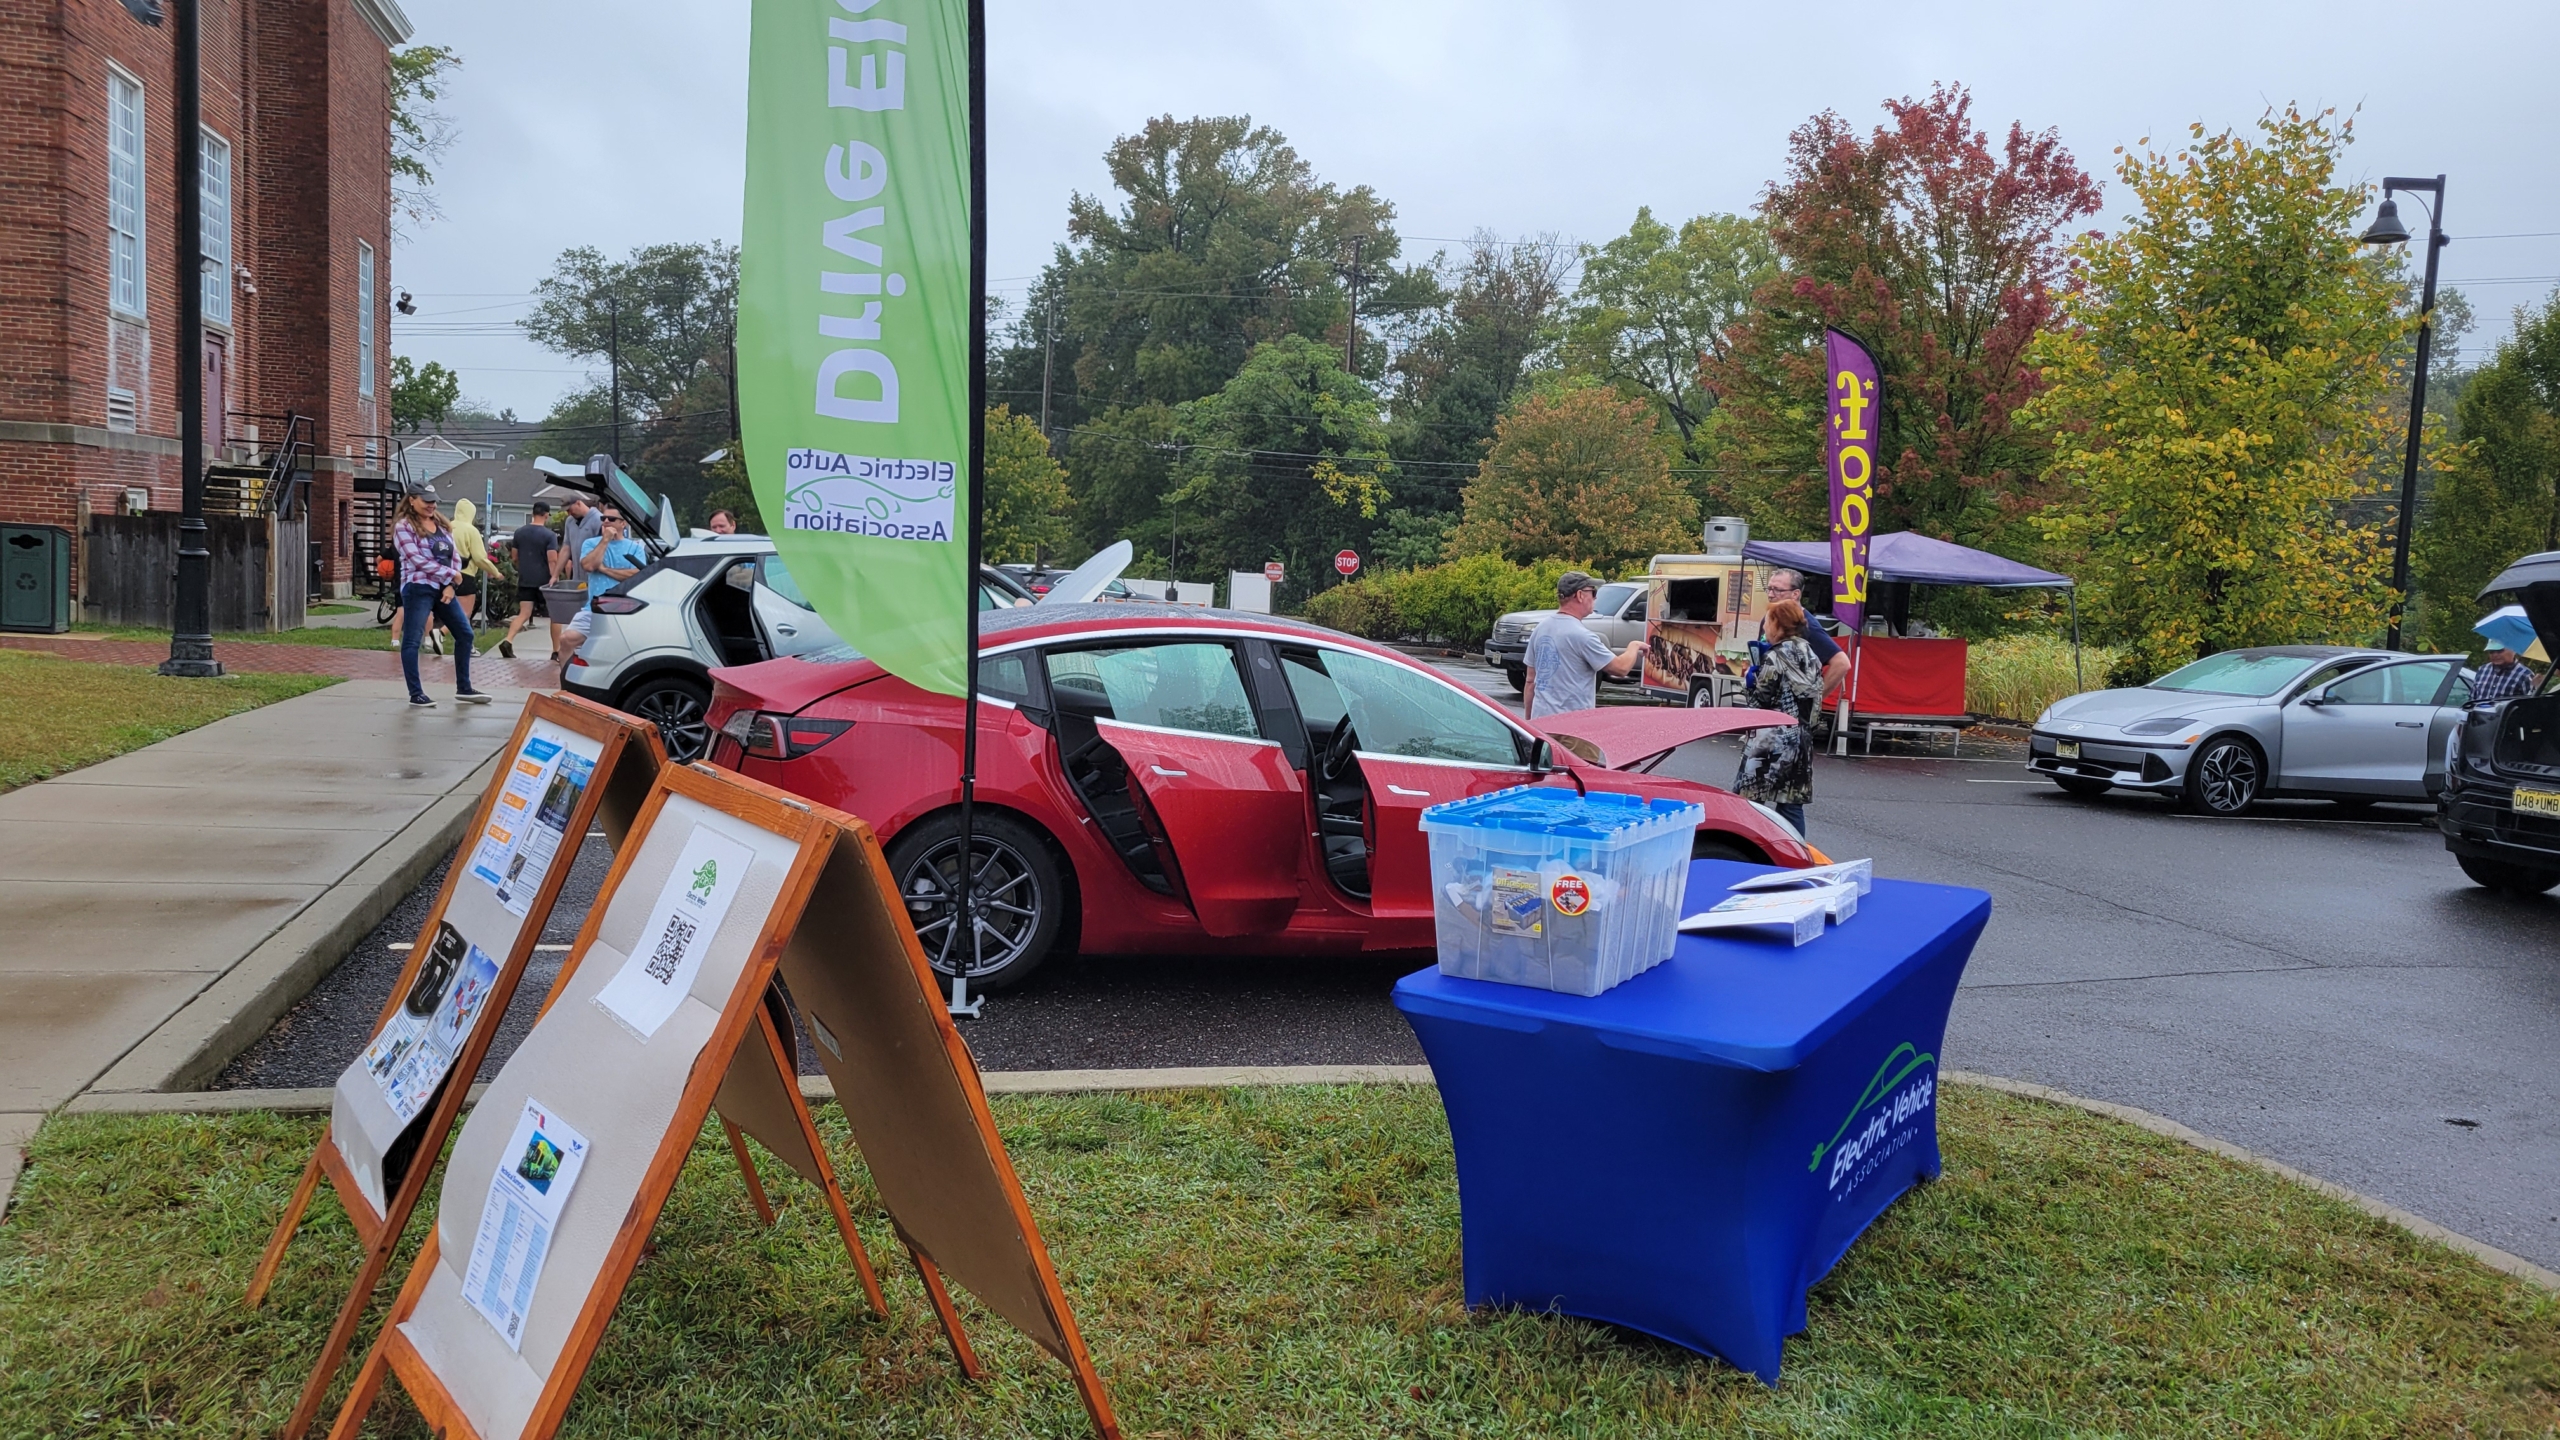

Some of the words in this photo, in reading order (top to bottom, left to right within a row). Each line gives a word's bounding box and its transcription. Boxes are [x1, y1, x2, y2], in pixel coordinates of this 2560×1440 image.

[1337, 557, 1358, 567] STOP
[1556, 880, 1583, 889] FREE
[1829, 1106, 1892, 1192] Electric
[1891, 1073, 1933, 1130] Vehicle
[1846, 1127, 1914, 1197] ASSOCIATION
